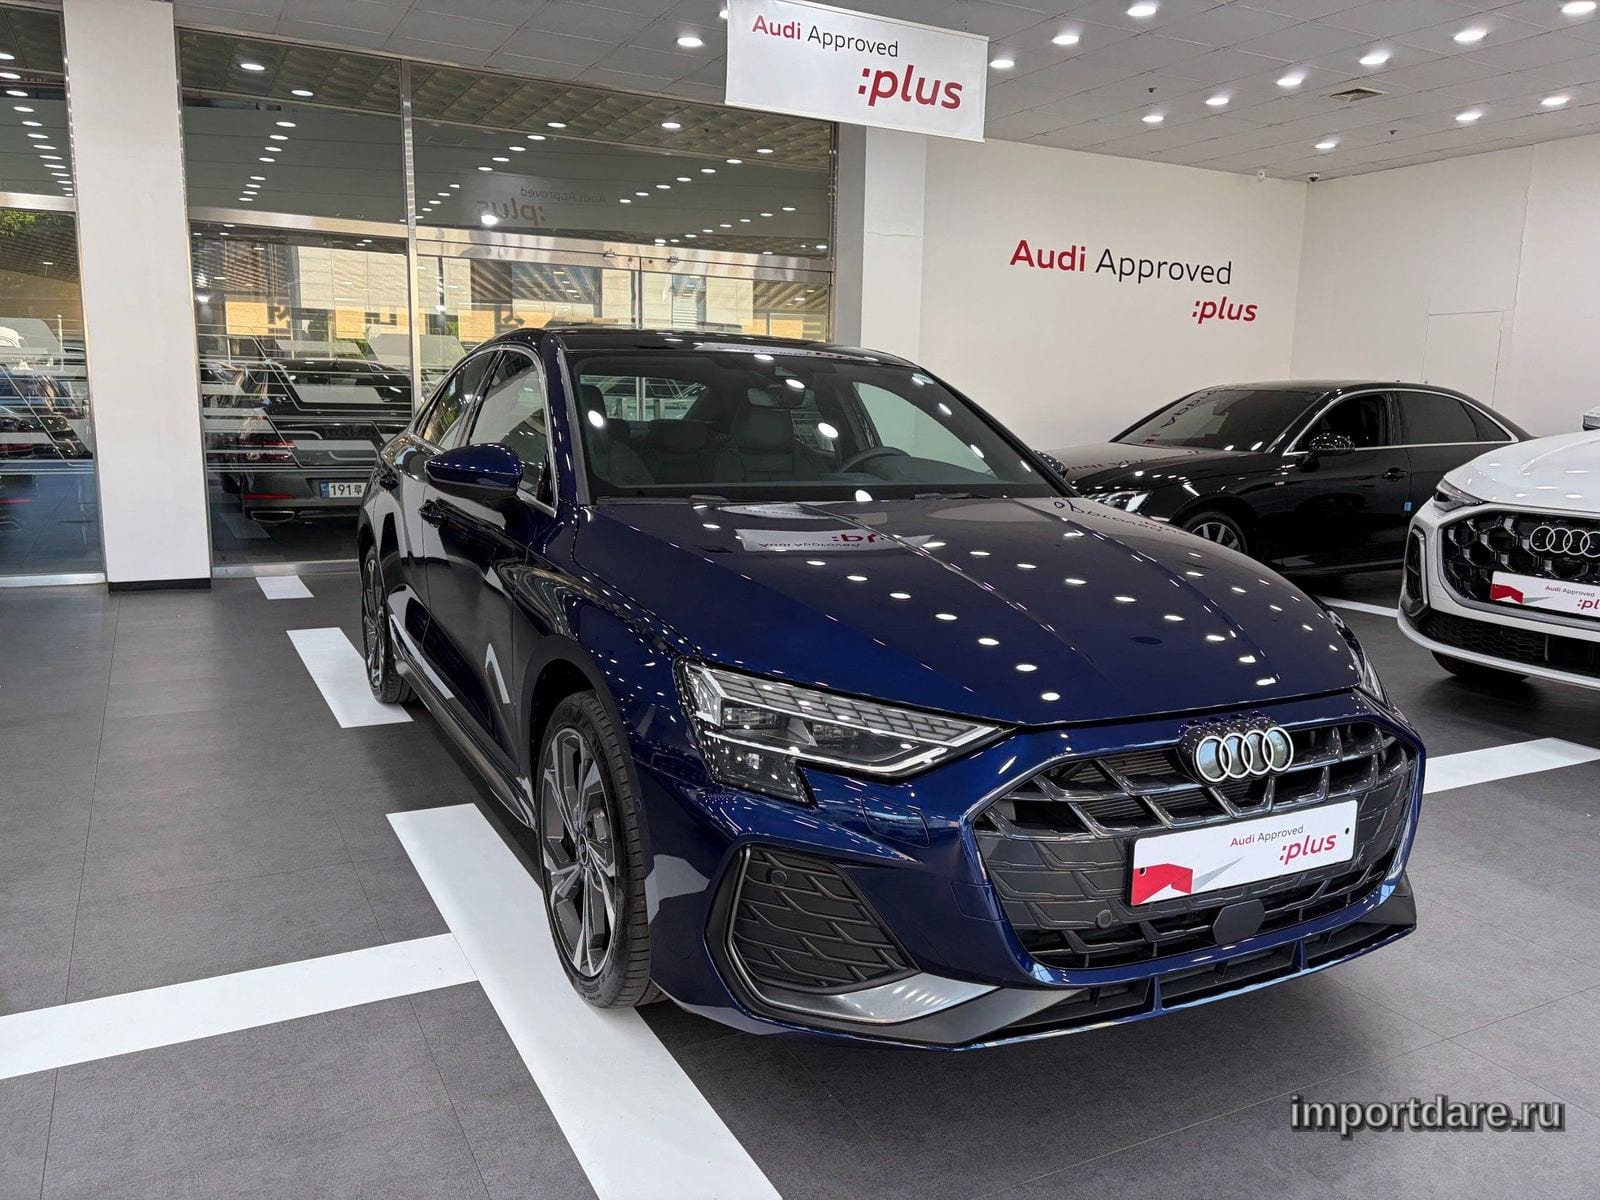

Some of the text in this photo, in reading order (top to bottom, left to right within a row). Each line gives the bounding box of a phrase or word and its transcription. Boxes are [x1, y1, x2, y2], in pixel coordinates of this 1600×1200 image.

[752, 15, 899, 58] Audi Approved
[857, 64, 963, 110] :plus
[1009, 240, 1232, 285] Audi Approved
[1191, 296, 1258, 324] :plus
[1562, 588, 1595, 598] Approved
[1577, 599, 1600, 610] :pl
[1230, 824, 1304, 847] Audi Approved
[1279, 834, 1337, 865] :plus
